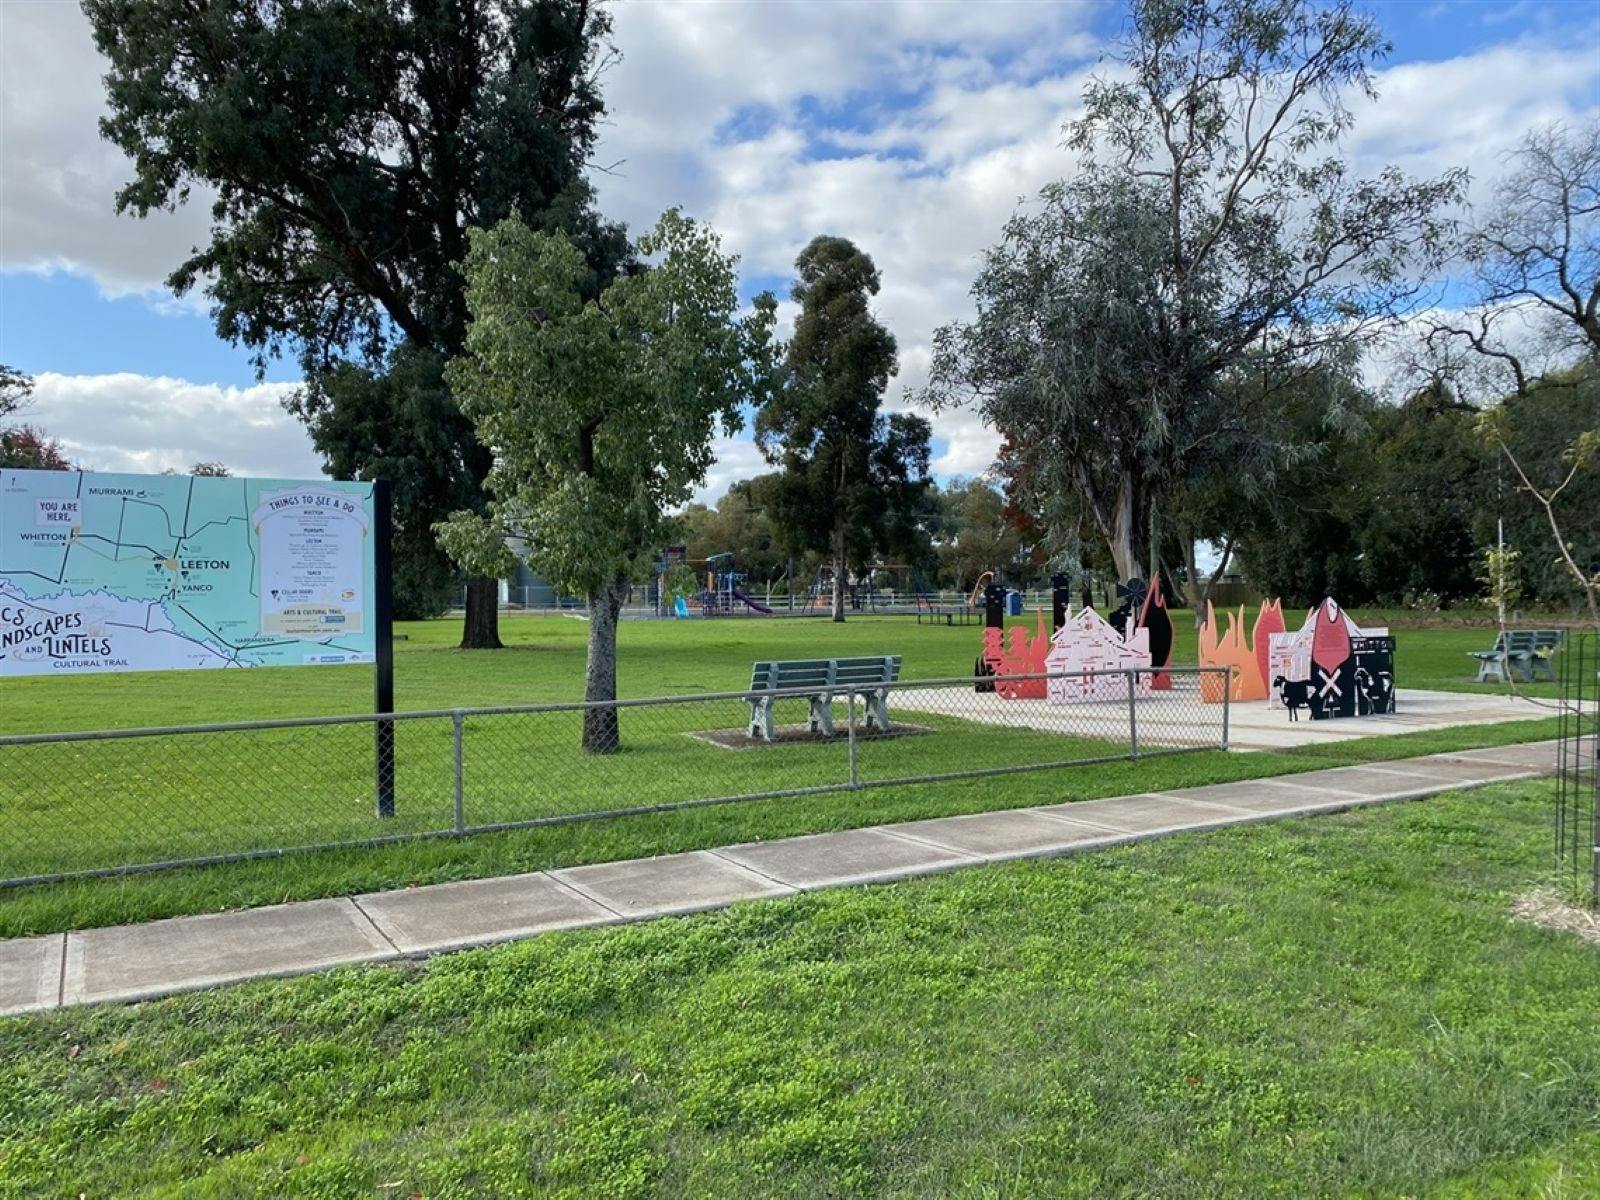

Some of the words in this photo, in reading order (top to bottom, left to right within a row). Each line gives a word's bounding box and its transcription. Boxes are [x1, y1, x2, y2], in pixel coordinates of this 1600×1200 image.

[88, 487, 134, 495] MURRAMI
[40, 502, 58, 512] YOU
[61, 502, 78, 512] ARE
[269, 496, 300, 511] THINGS
[302, 495, 314, 504] TO
[315, 496, 331, 506] SEE
[334, 500, 340, 508] &
[342, 502, 355, 513] DO
[20, 533, 67, 541] WHITTON
[181, 560, 230, 569] LEETON
[25, 646, 43, 654] AND
[43, 633, 112, 659] LINTELS
[53, 659, 101, 669] CULTURAL
[104, 658, 129, 667] TRAIL
